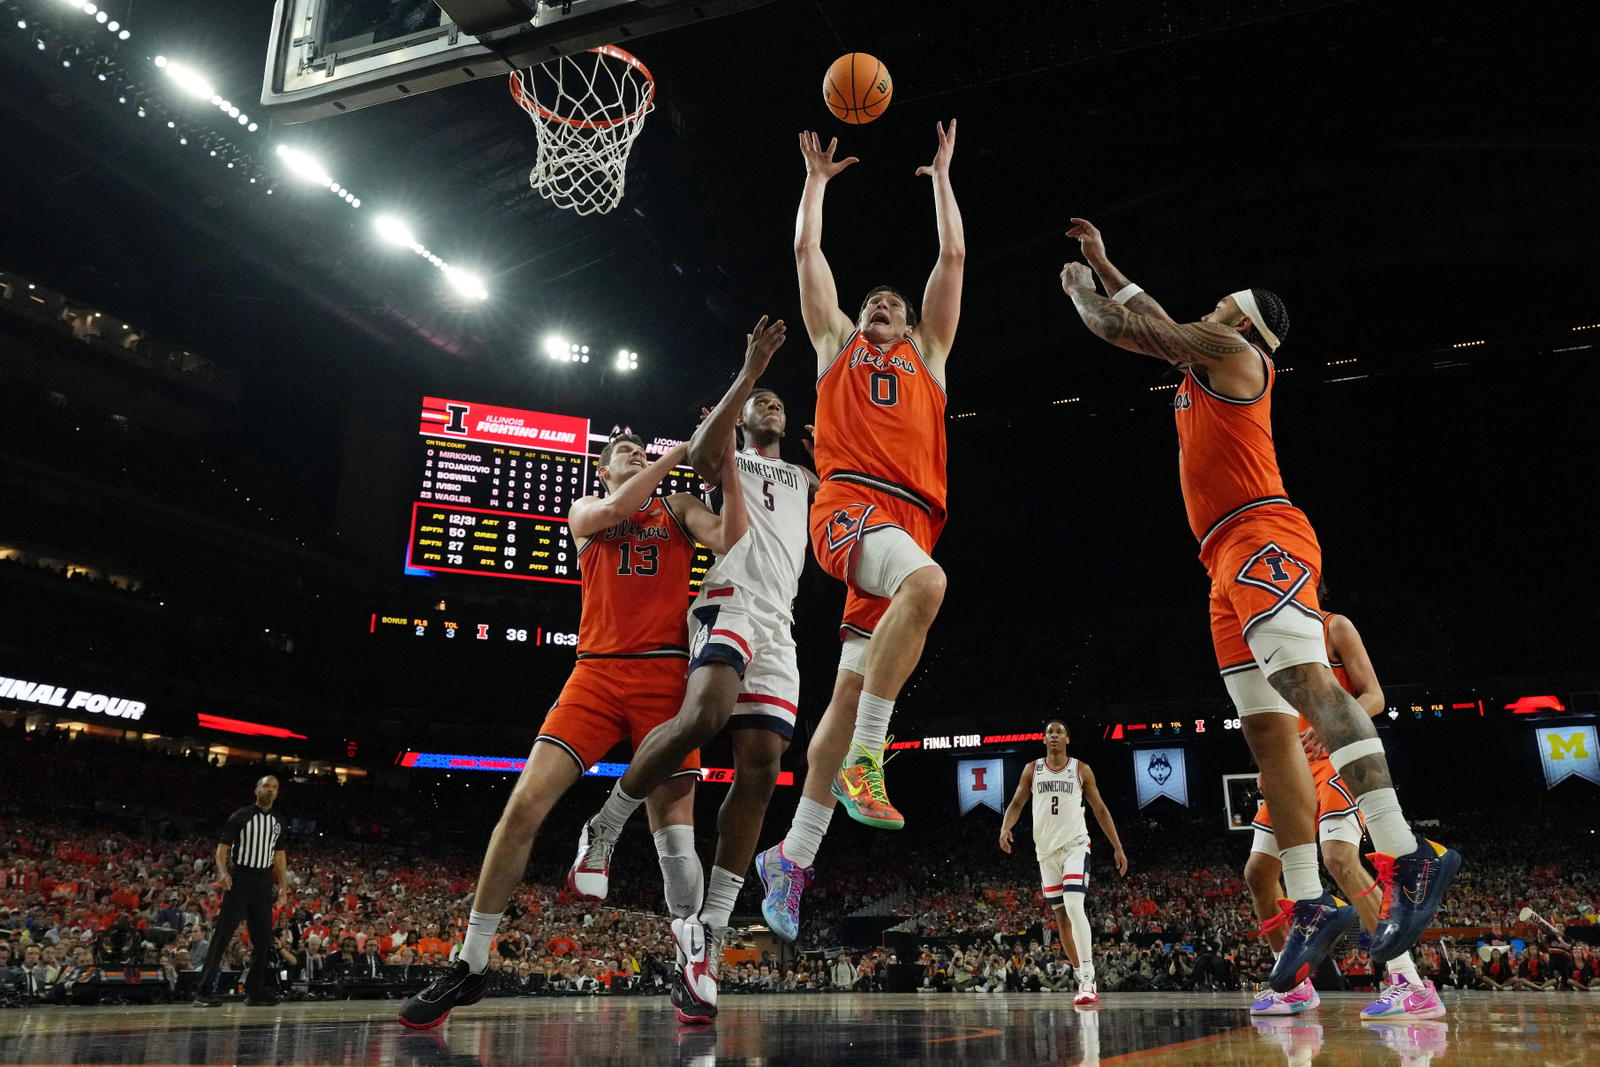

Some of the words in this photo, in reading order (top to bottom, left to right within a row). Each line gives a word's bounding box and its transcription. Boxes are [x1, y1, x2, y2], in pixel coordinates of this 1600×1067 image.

[870, 372, 898, 406] 0
[444, 403, 470, 435] I
[486, 415, 525, 426] ILLINOIS
[476, 421, 539, 438] FIGHTING
[539, 429, 576, 443] ILLINI
[438, 461, 490, 474] STOJAKOVIC
[525, 471, 532, 479] 0
[555, 475, 563, 483] 0
[439, 451, 481, 462] MIRKOVIC
[510, 459, 517, 467] 2
[556, 465, 563, 473] 3
[436, 482, 461, 491] IVISIC
[523, 492, 530, 500] 0
[437, 472, 477, 483] BOSWELL
[555, 485, 562, 493] 0
[435, 493, 471, 503] WAGLER
[538, 504, 545, 512] 0
[553, 506, 561, 514] 0
[762, 480, 775, 512] 5
[449, 514, 476, 526] 12/31
[508, 521, 516, 530] 2
[560, 526, 568, 536] 4
[449, 527, 466, 538] 50
[559, 539, 567, 549] 4
[448, 541, 464, 551] 27
[557, 552, 566, 562] 0
[617, 542, 659, 576] 13
[447, 554, 463, 565] 73
[504, 560, 514, 570] 0
[555, 565, 568, 575] 14
[1264, 556, 1291, 582] I
[382, 617, 407, 625] BONUS
[414, 619, 428, 627] FLS
[444, 621, 458, 629] TOL
[415, 626, 425, 636] 2
[446, 628, 455, 639] 3
[506, 628, 527, 641] 36
[546, 631, 579, 646] 16:3
[67, 690, 146, 720] FOUR
[1223, 719, 1242, 730] 36
[923, 736, 952, 750] FINAL
[953, 734, 981, 748] FOUR
[983, 732, 1046, 744] INDIANAPOL
[1546, 732, 1590, 760] M
[708, 771, 726, 780] 16
[1037, 780, 1074, 794] CONNECTICUT
[1051, 796, 1059, 815] 2
